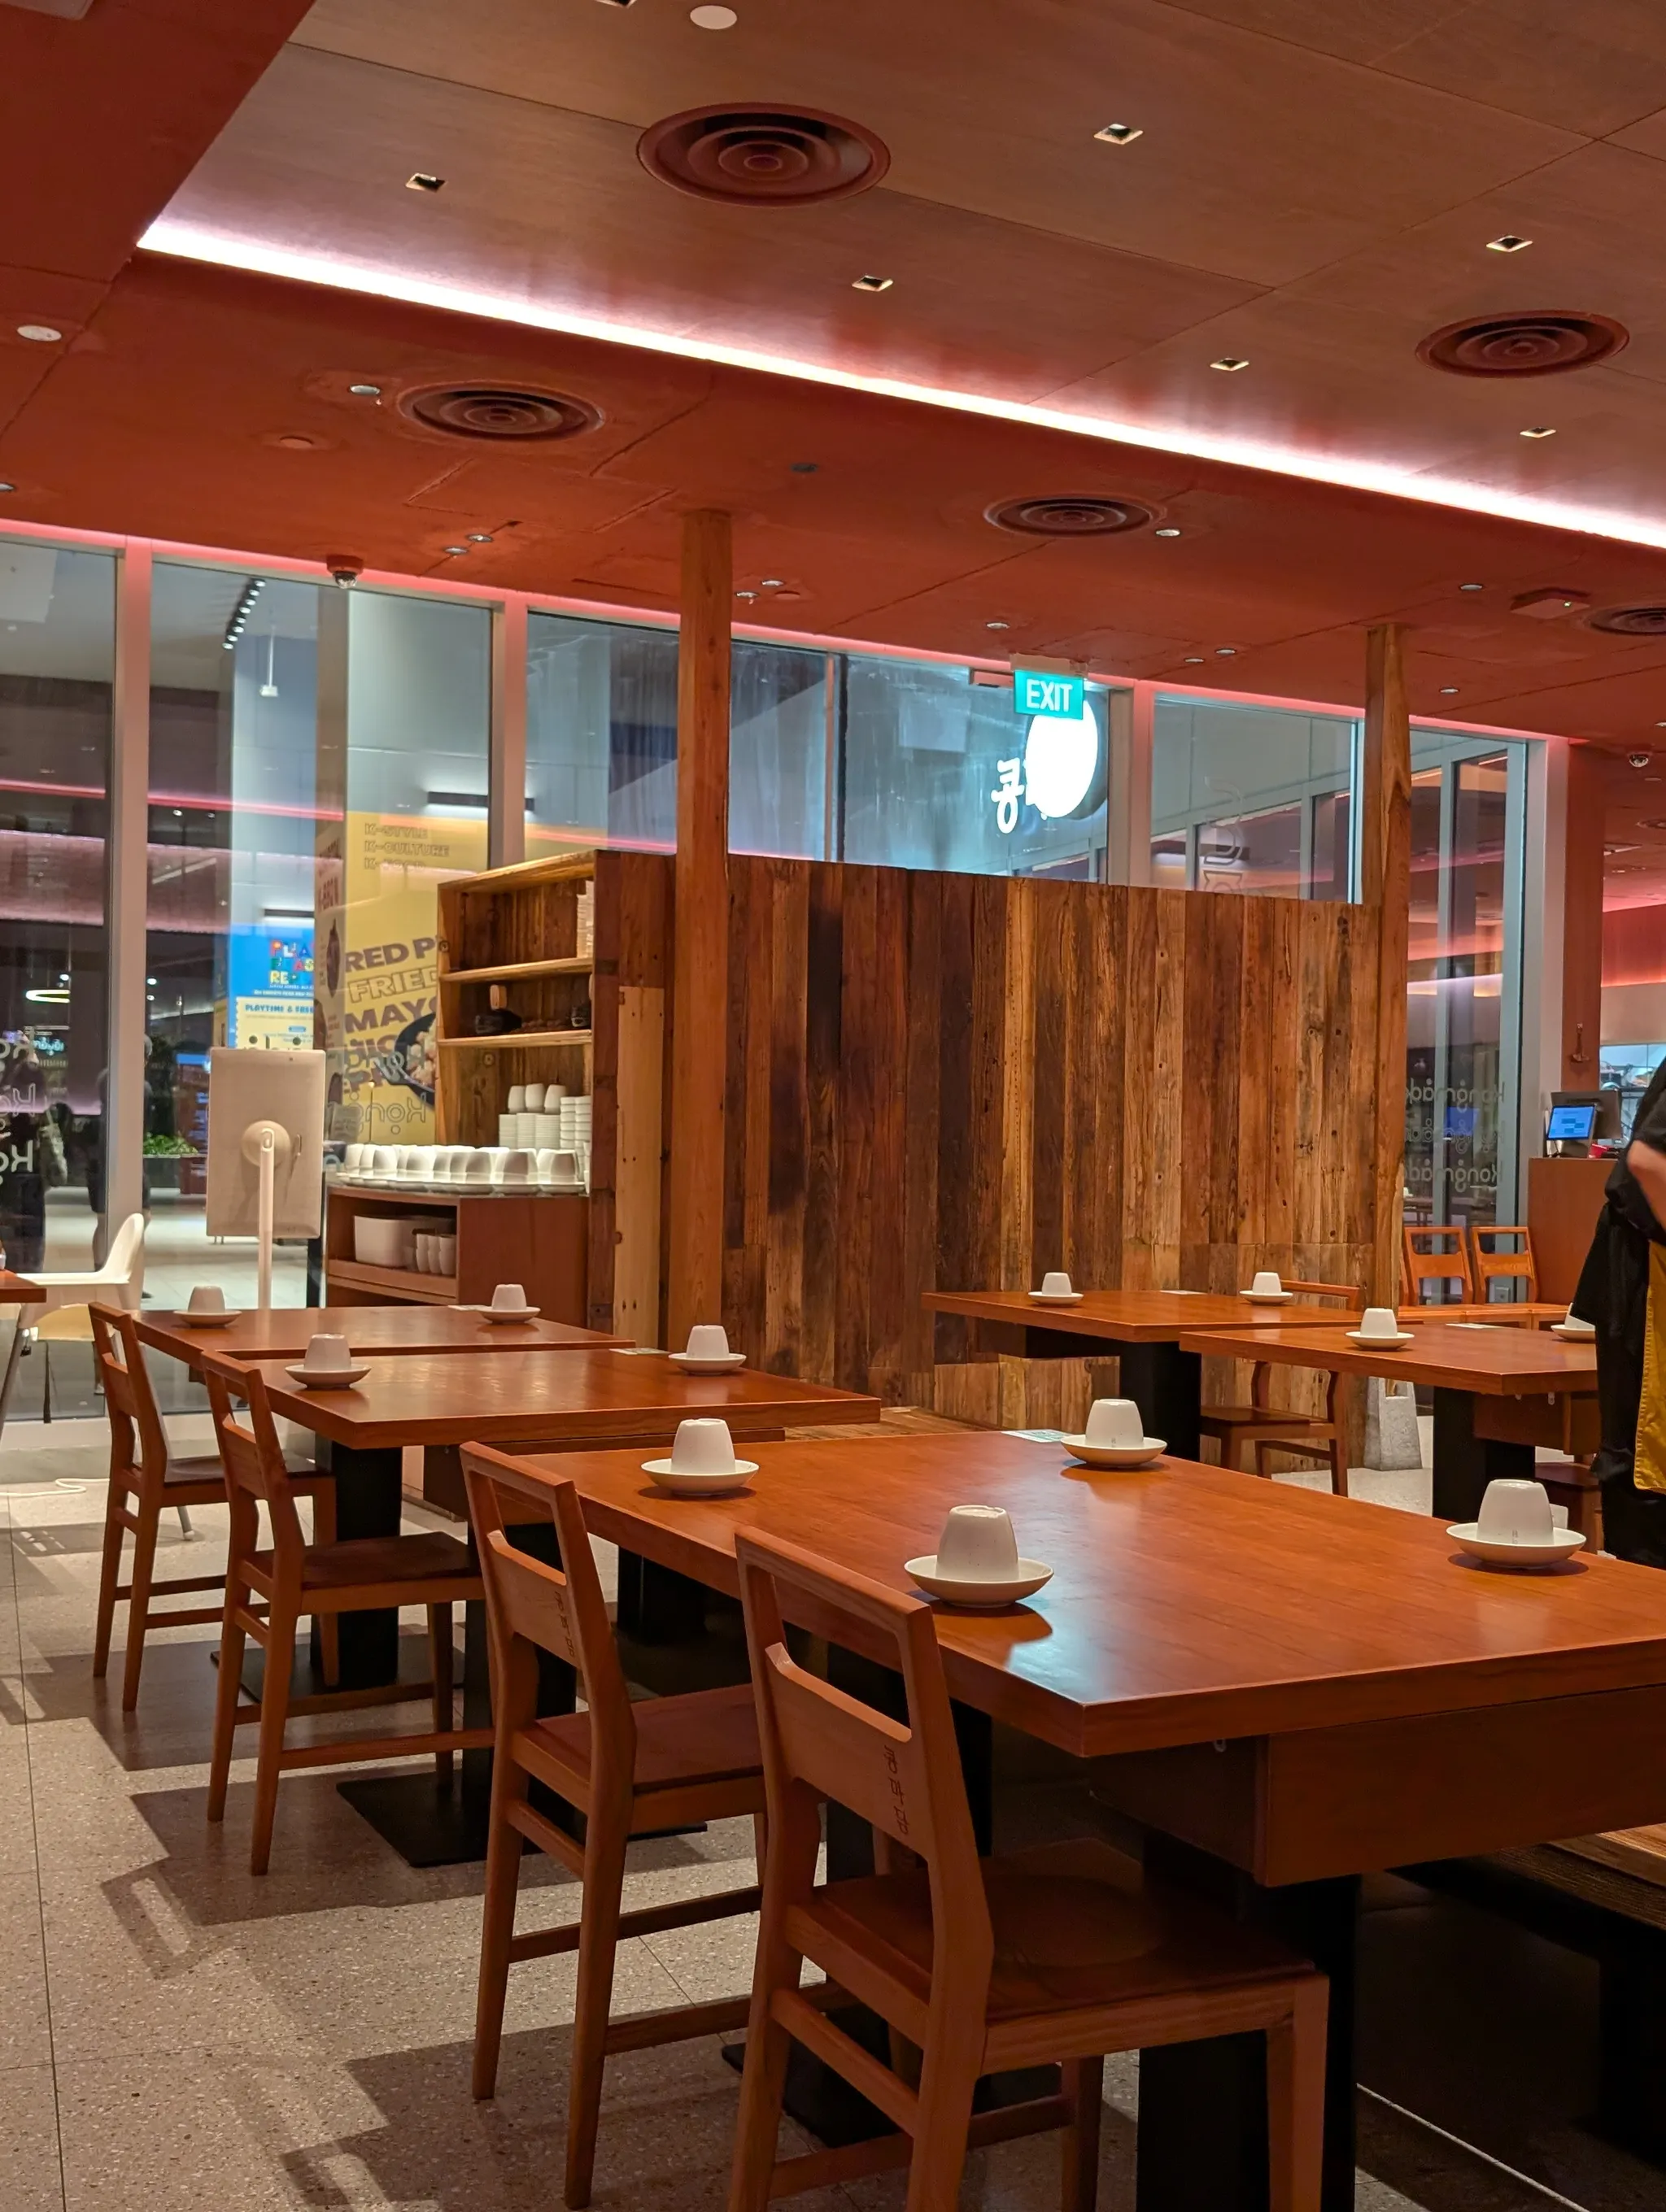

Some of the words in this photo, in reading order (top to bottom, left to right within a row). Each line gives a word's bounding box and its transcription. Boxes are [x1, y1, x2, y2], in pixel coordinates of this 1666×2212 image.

[1026, 678, 1073, 712] EXIT
[364, 822, 428, 839] K-STYLE
[364, 840, 449, 857] K-CULTURE
[345, 943, 409, 973] RED
[412, 937, 437, 960] P
